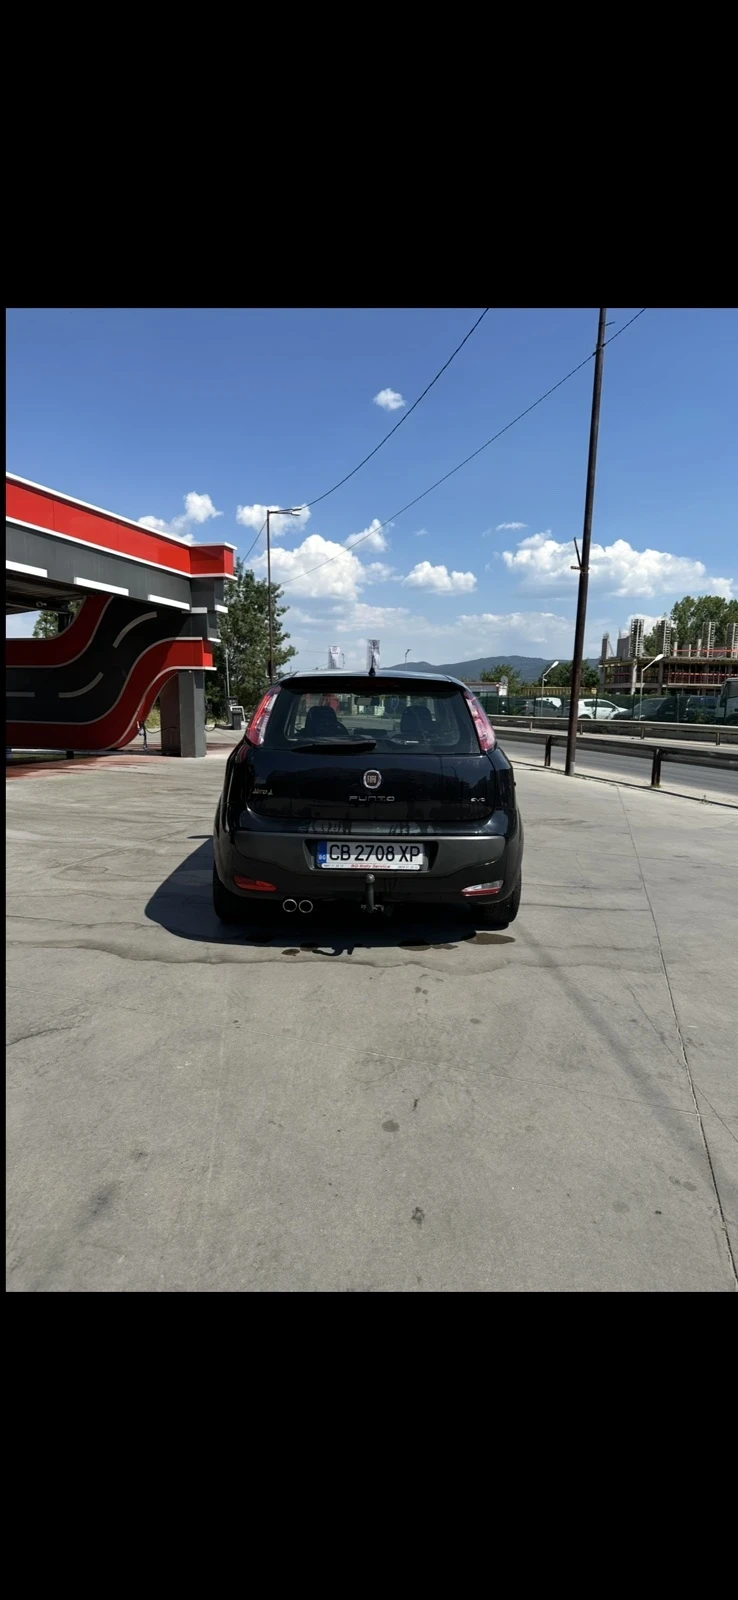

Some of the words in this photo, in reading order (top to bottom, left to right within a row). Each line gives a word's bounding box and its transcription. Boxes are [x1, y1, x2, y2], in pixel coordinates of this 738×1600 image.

[329, 844, 351, 861] CB
[354, 845, 395, 862] 2708
[399, 845, 420, 863] XP
